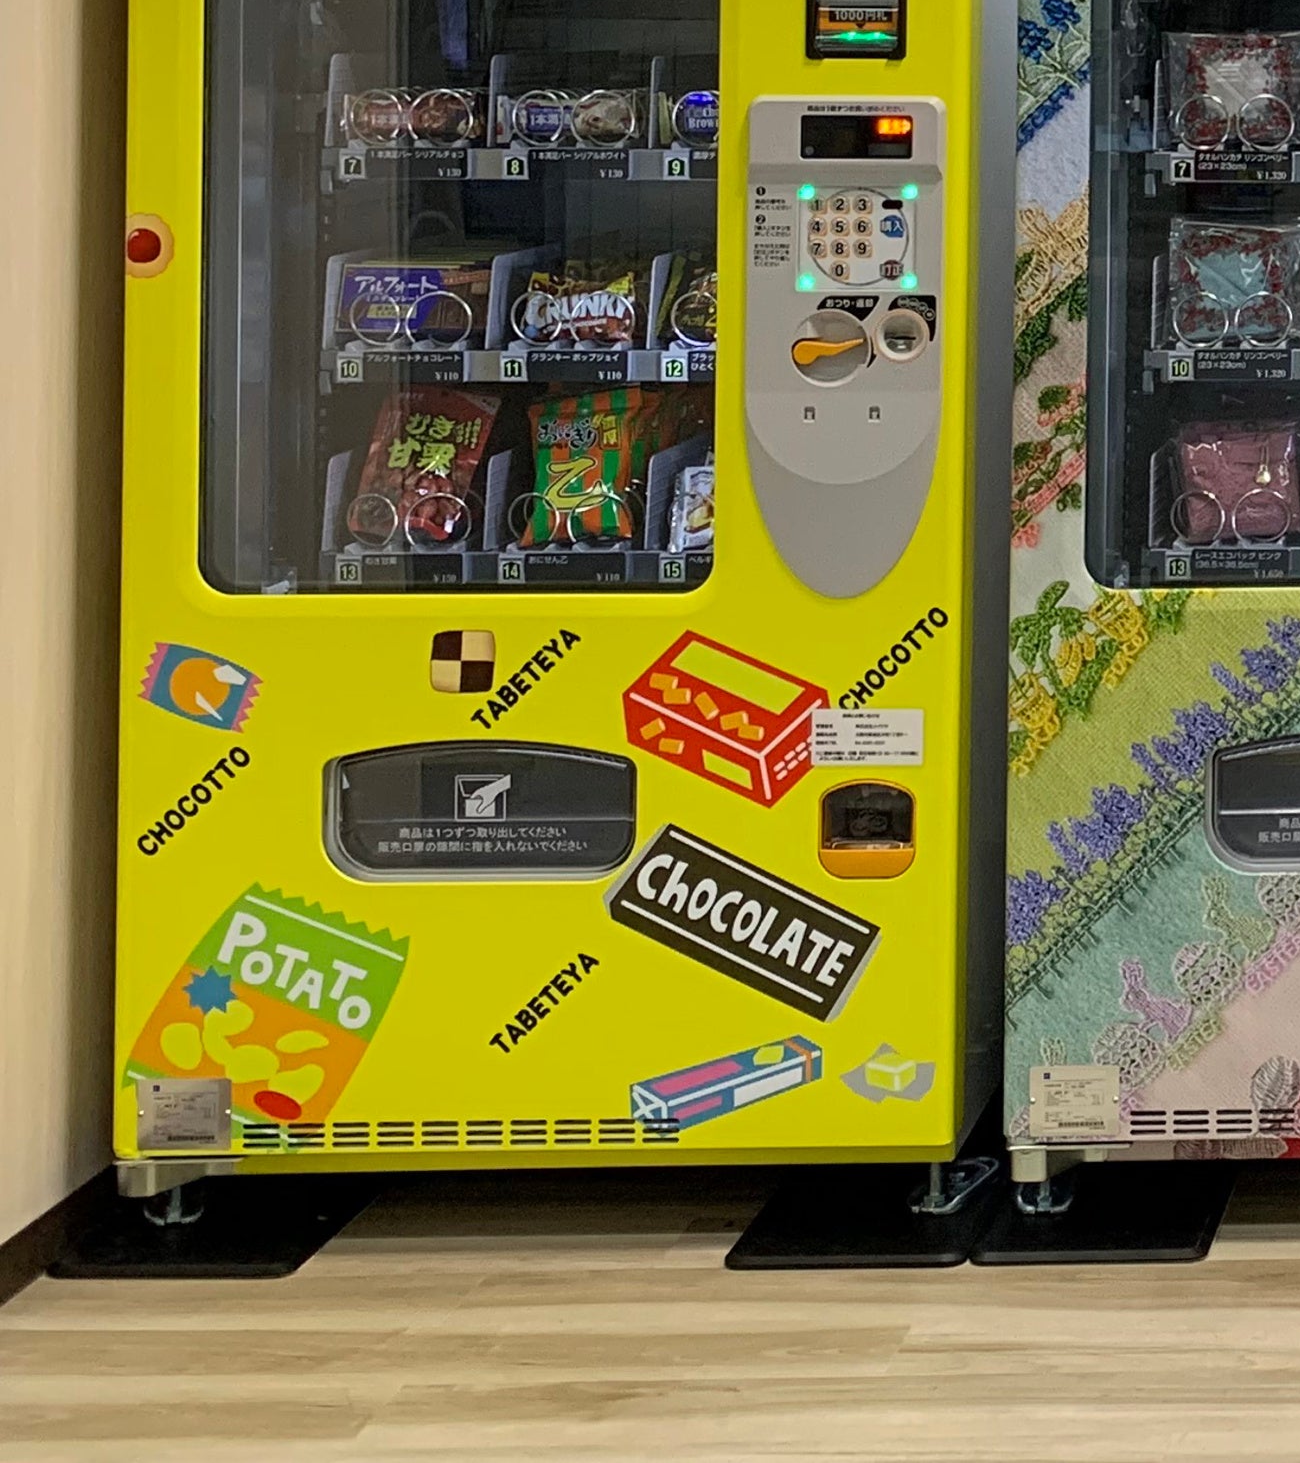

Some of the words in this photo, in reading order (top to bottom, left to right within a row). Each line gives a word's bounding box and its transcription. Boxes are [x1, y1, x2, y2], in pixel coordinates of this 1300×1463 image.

[510, 159, 520, 174] 8
[1244, 153, 1289, 163] リンゴンベリー
[671, 159, 681, 175] 9
[1177, 162, 1187, 178] 7
[353, 274, 439, 294] アルフォート
[524, 291, 636, 330] CRUNKY
[366, 353, 462, 363] アルフォートチョコレート
[530, 353, 573, 363] クランキー
[340, 361, 359, 378] 10
[434, 371, 460, 381] ¥110
[504, 360, 522, 377] 11
[597, 371, 623, 381] ¥110
[665, 361, 684, 378] 12
[1172, 359, 1189, 376] 10
[404, 414, 455, 438] むき
[388, 439, 456, 474] 甘栗
[340, 563, 358, 579] 13
[502, 562, 520, 579] 14
[663, 561, 681, 578] 15
[1169, 559, 1186, 576] 13
[837, 605, 950, 711] CHOCOTTO
[471, 627, 581, 732] TABETEYA
[137, 745, 251, 858] CHOCOTTO
[399, 827, 567, 839] 商品は1つずつ取り出してください
[216, 910, 373, 1032] POTATO
[489, 951, 600, 1056] TABETEYA
